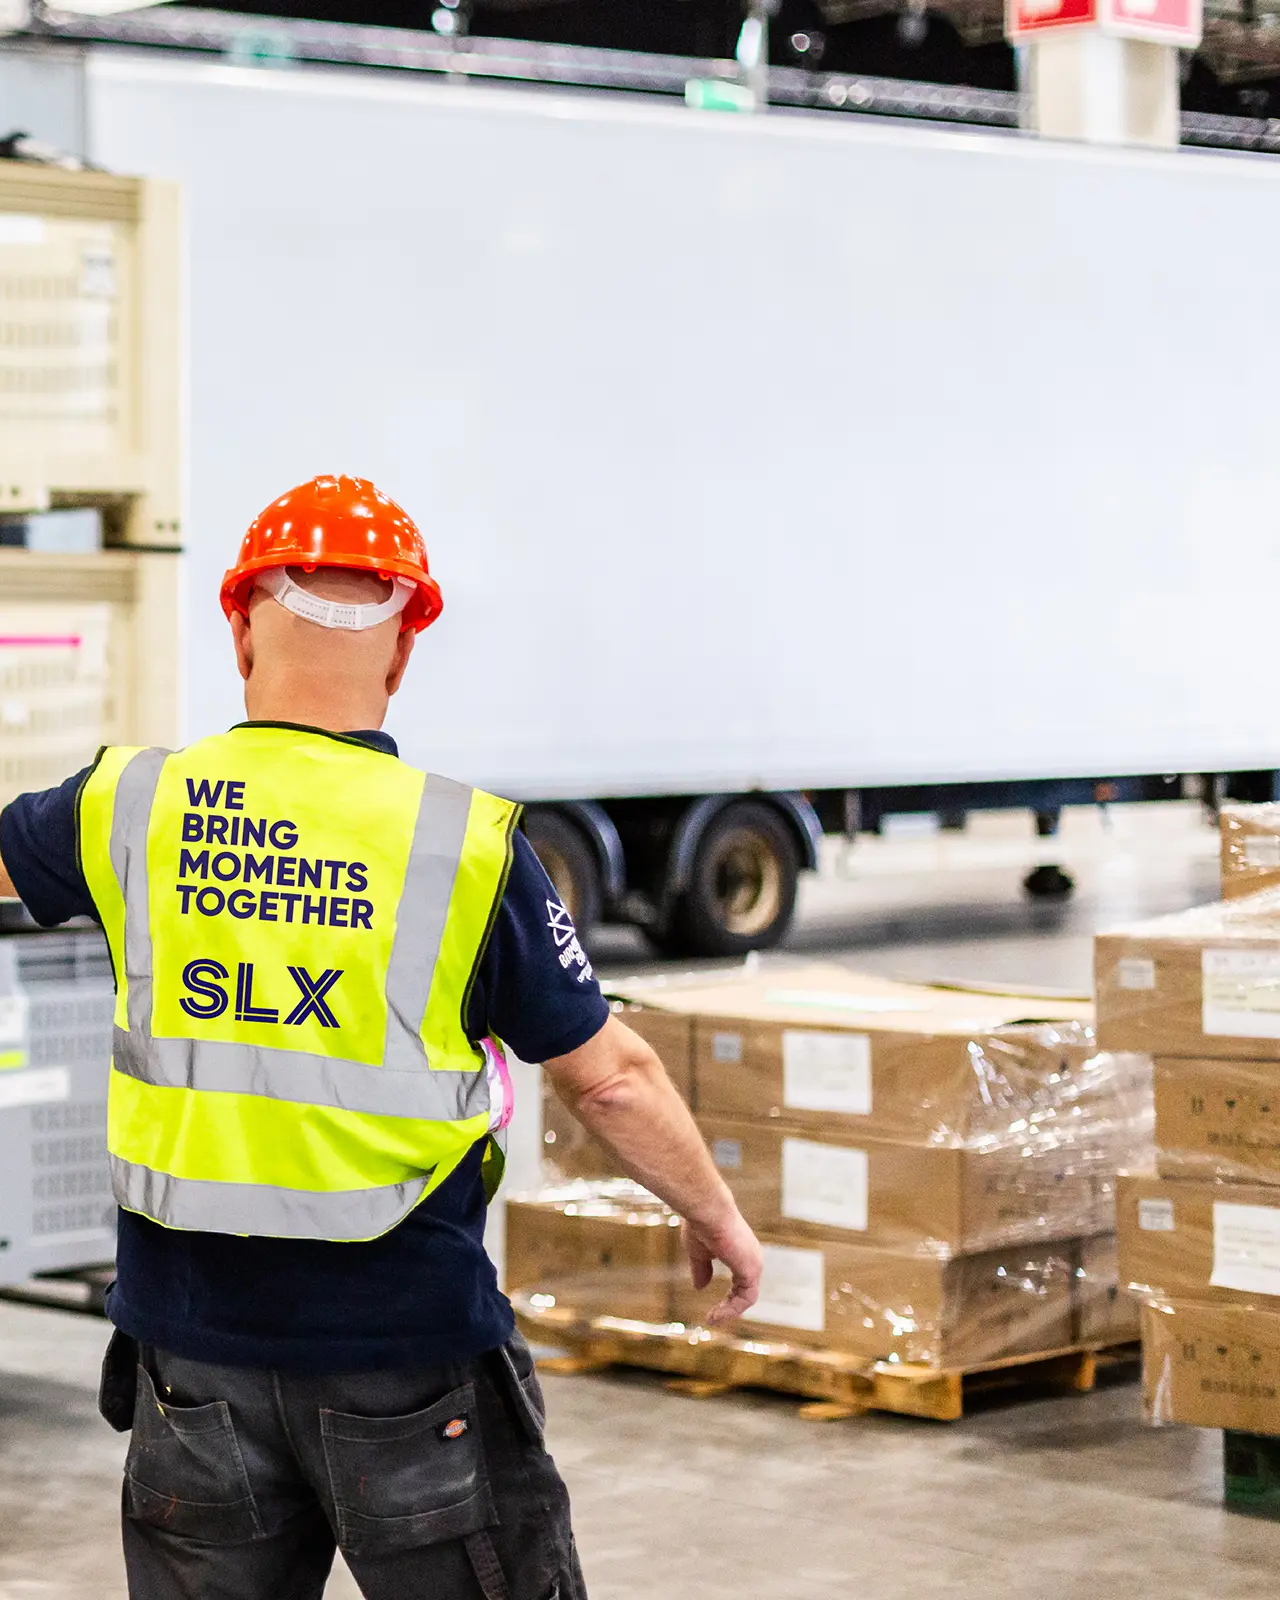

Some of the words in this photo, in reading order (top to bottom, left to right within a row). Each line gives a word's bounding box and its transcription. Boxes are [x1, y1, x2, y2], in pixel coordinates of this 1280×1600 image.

[186, 778, 246, 810] WE
[182, 813, 299, 850] BRING
[179, 849, 368, 892] MOMENTS
[176, 885, 374, 929] TOGETHER
[179, 959, 344, 1028] SLX
